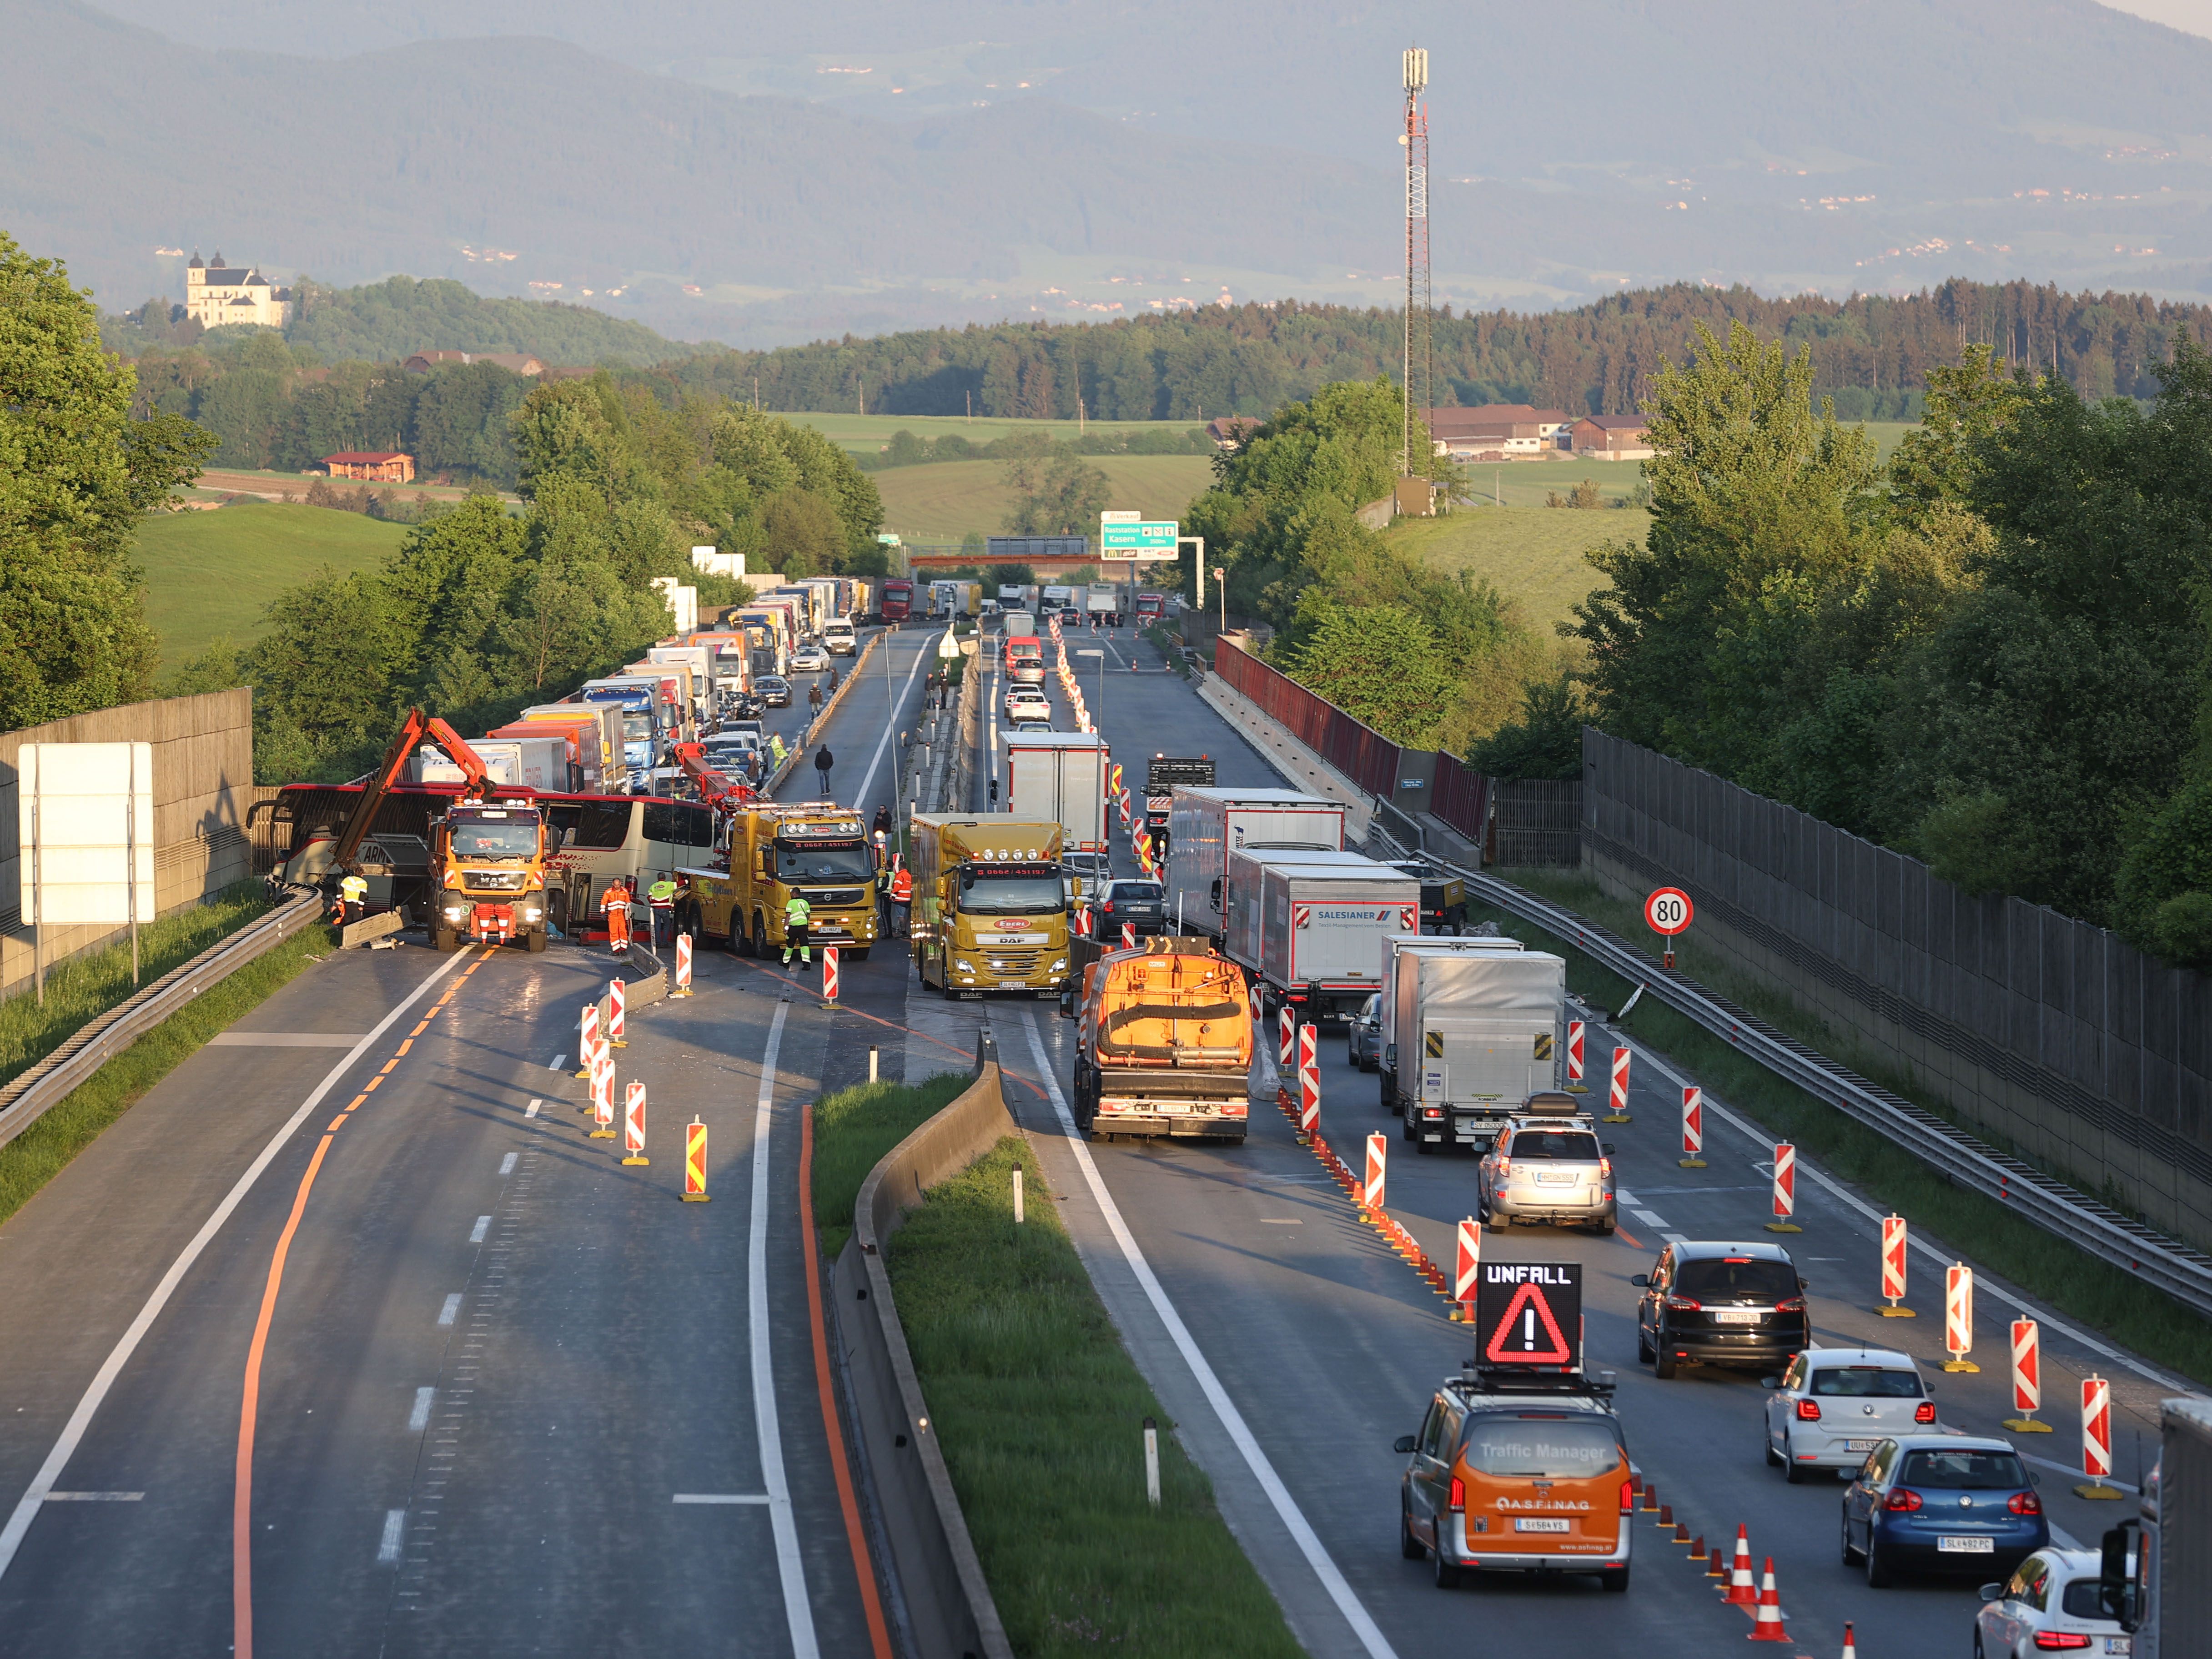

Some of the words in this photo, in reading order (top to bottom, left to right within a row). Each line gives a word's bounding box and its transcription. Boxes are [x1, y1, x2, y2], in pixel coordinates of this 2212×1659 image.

[1657, 900, 1681, 922] 80
[1487, 1266, 1571, 1284] UNFALL
[1481, 1443, 1532, 1458] Traffic
[1536, 1444, 1606, 1462] Manager
[1526, 1520, 1531, 1529] S
[1536, 1521, 1552, 1530] 564
[1553, 1521, 1563, 1530] VS
[1559, 1543, 1612, 1552] www.asfinag.at
[2114, 1641, 2123, 1650] SL
